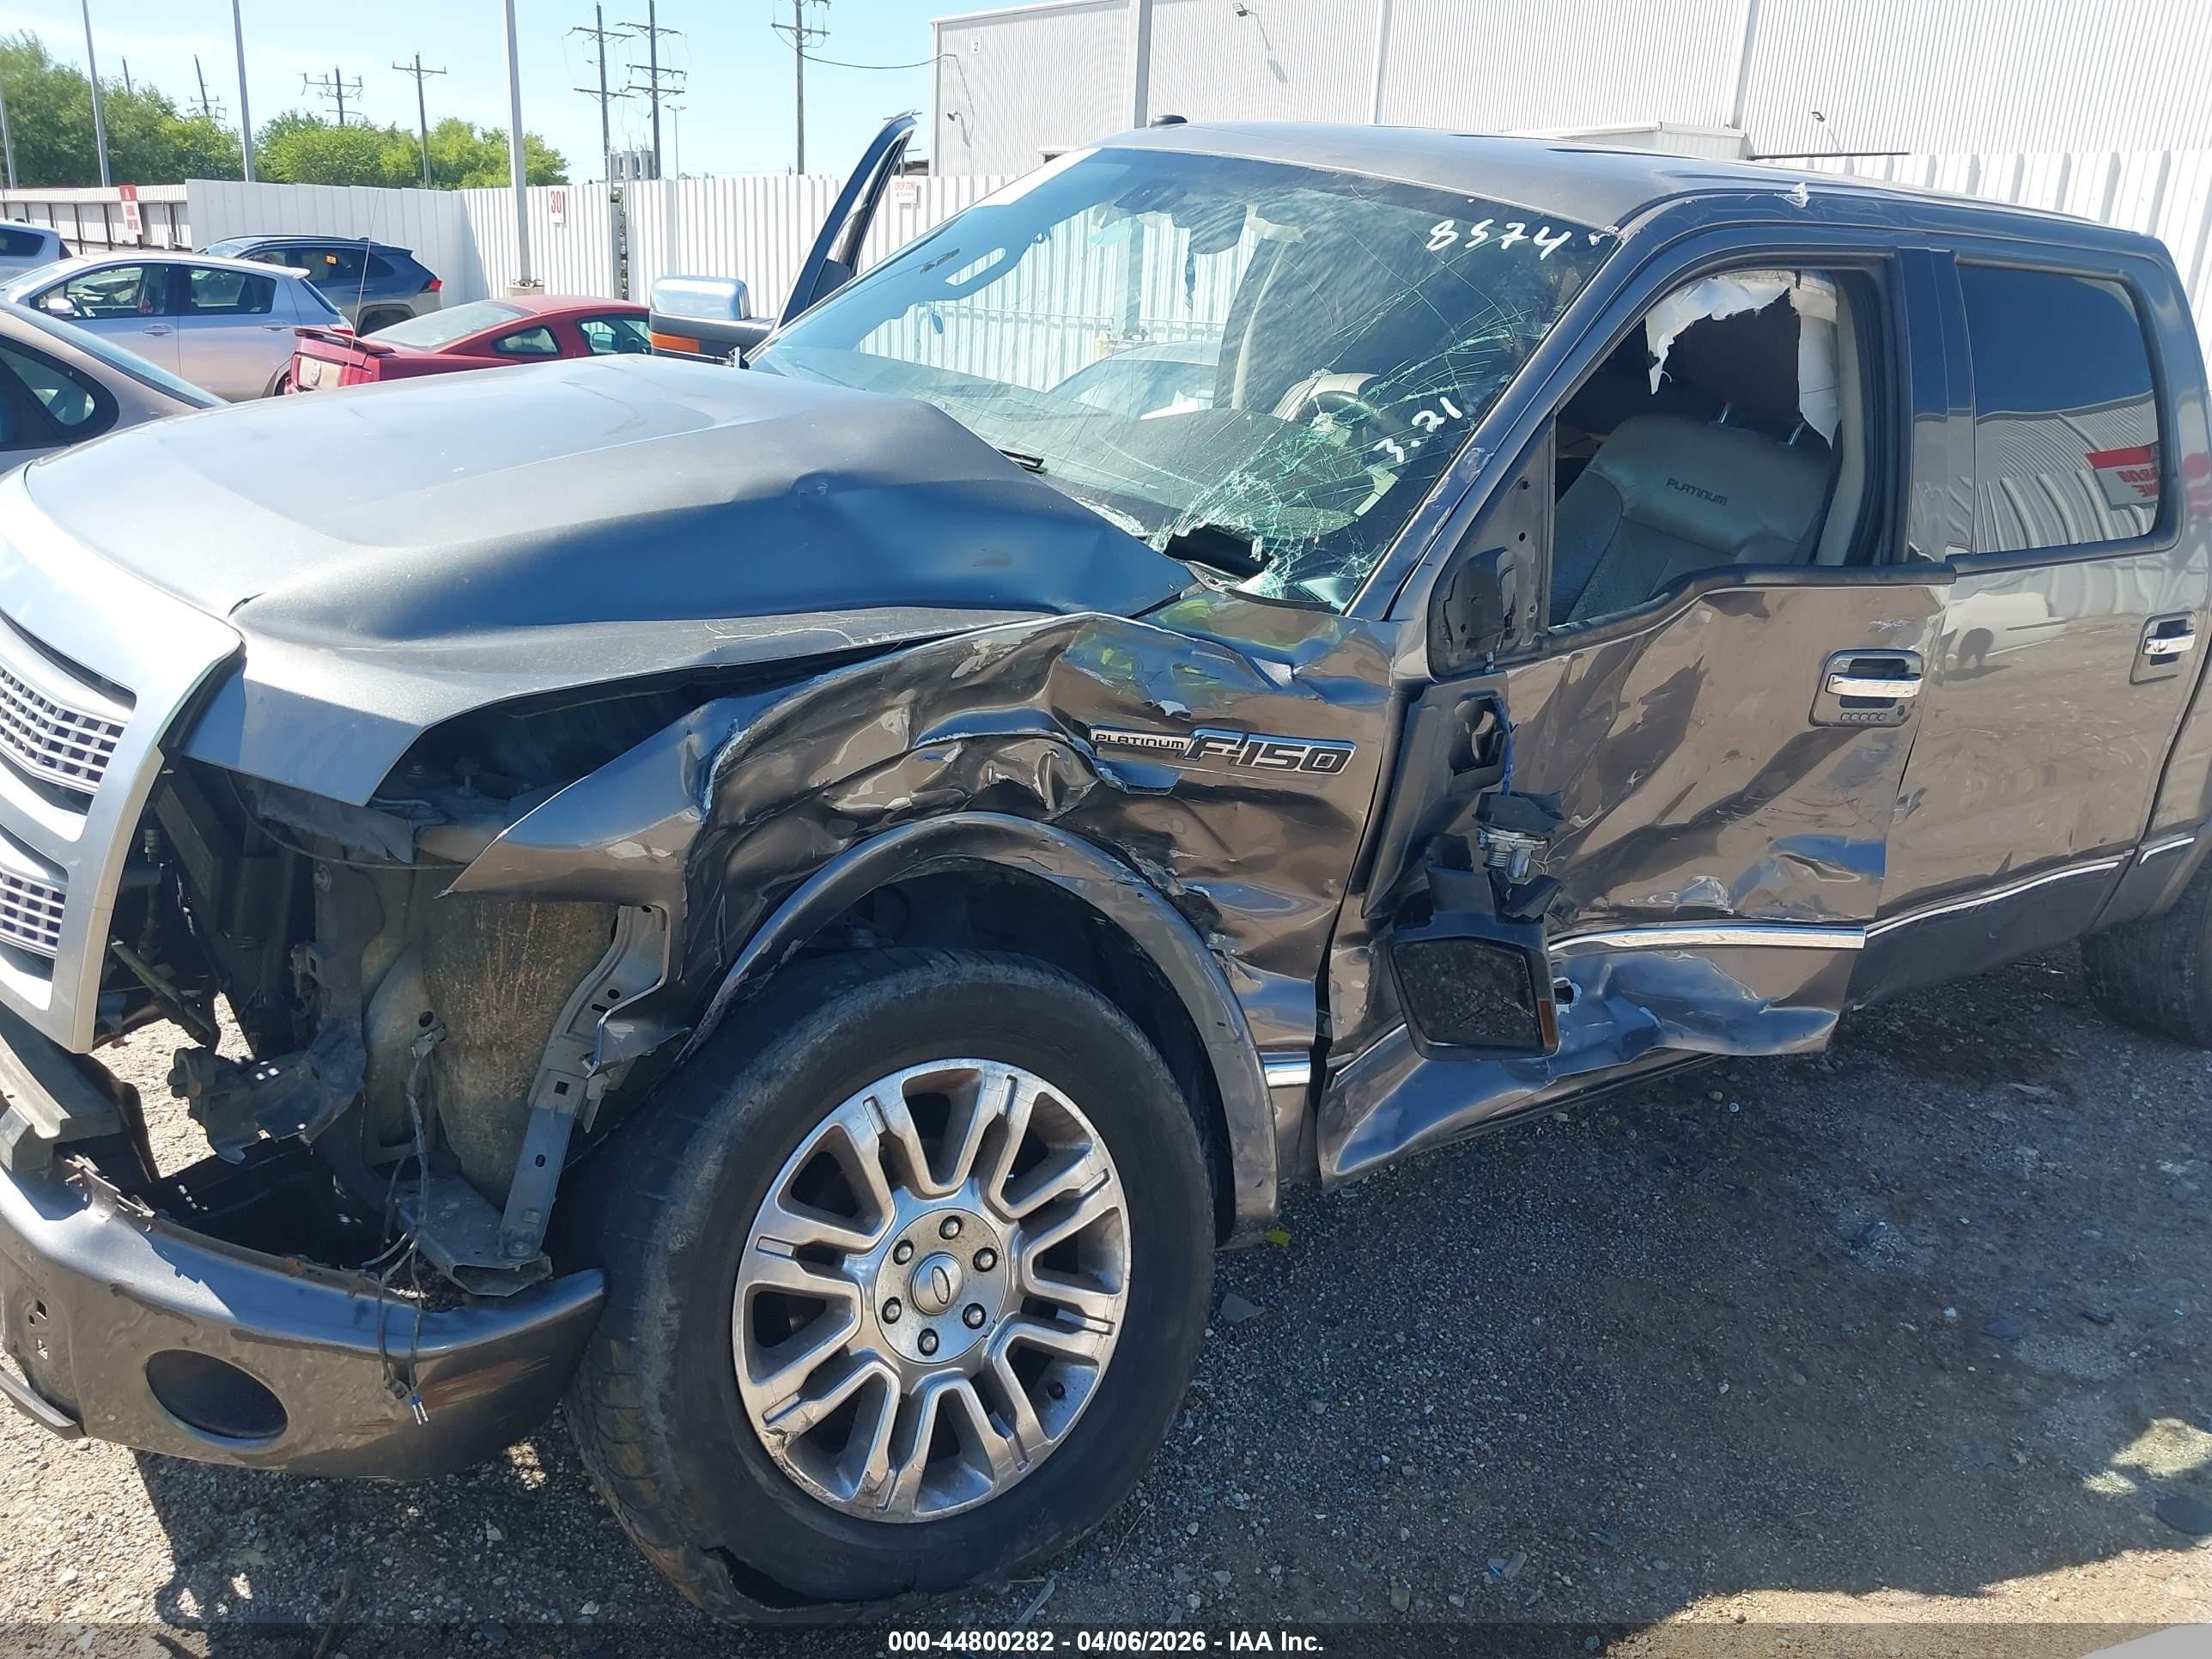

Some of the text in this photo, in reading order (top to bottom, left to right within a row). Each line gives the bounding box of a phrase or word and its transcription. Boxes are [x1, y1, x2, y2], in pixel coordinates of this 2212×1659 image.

[550, 190, 562, 214] 30
[1425, 218, 1572, 261] 8574
[1666, 477, 1728, 507] PLATINUM
[1094, 728, 1358, 775] PLATINUM F-150
